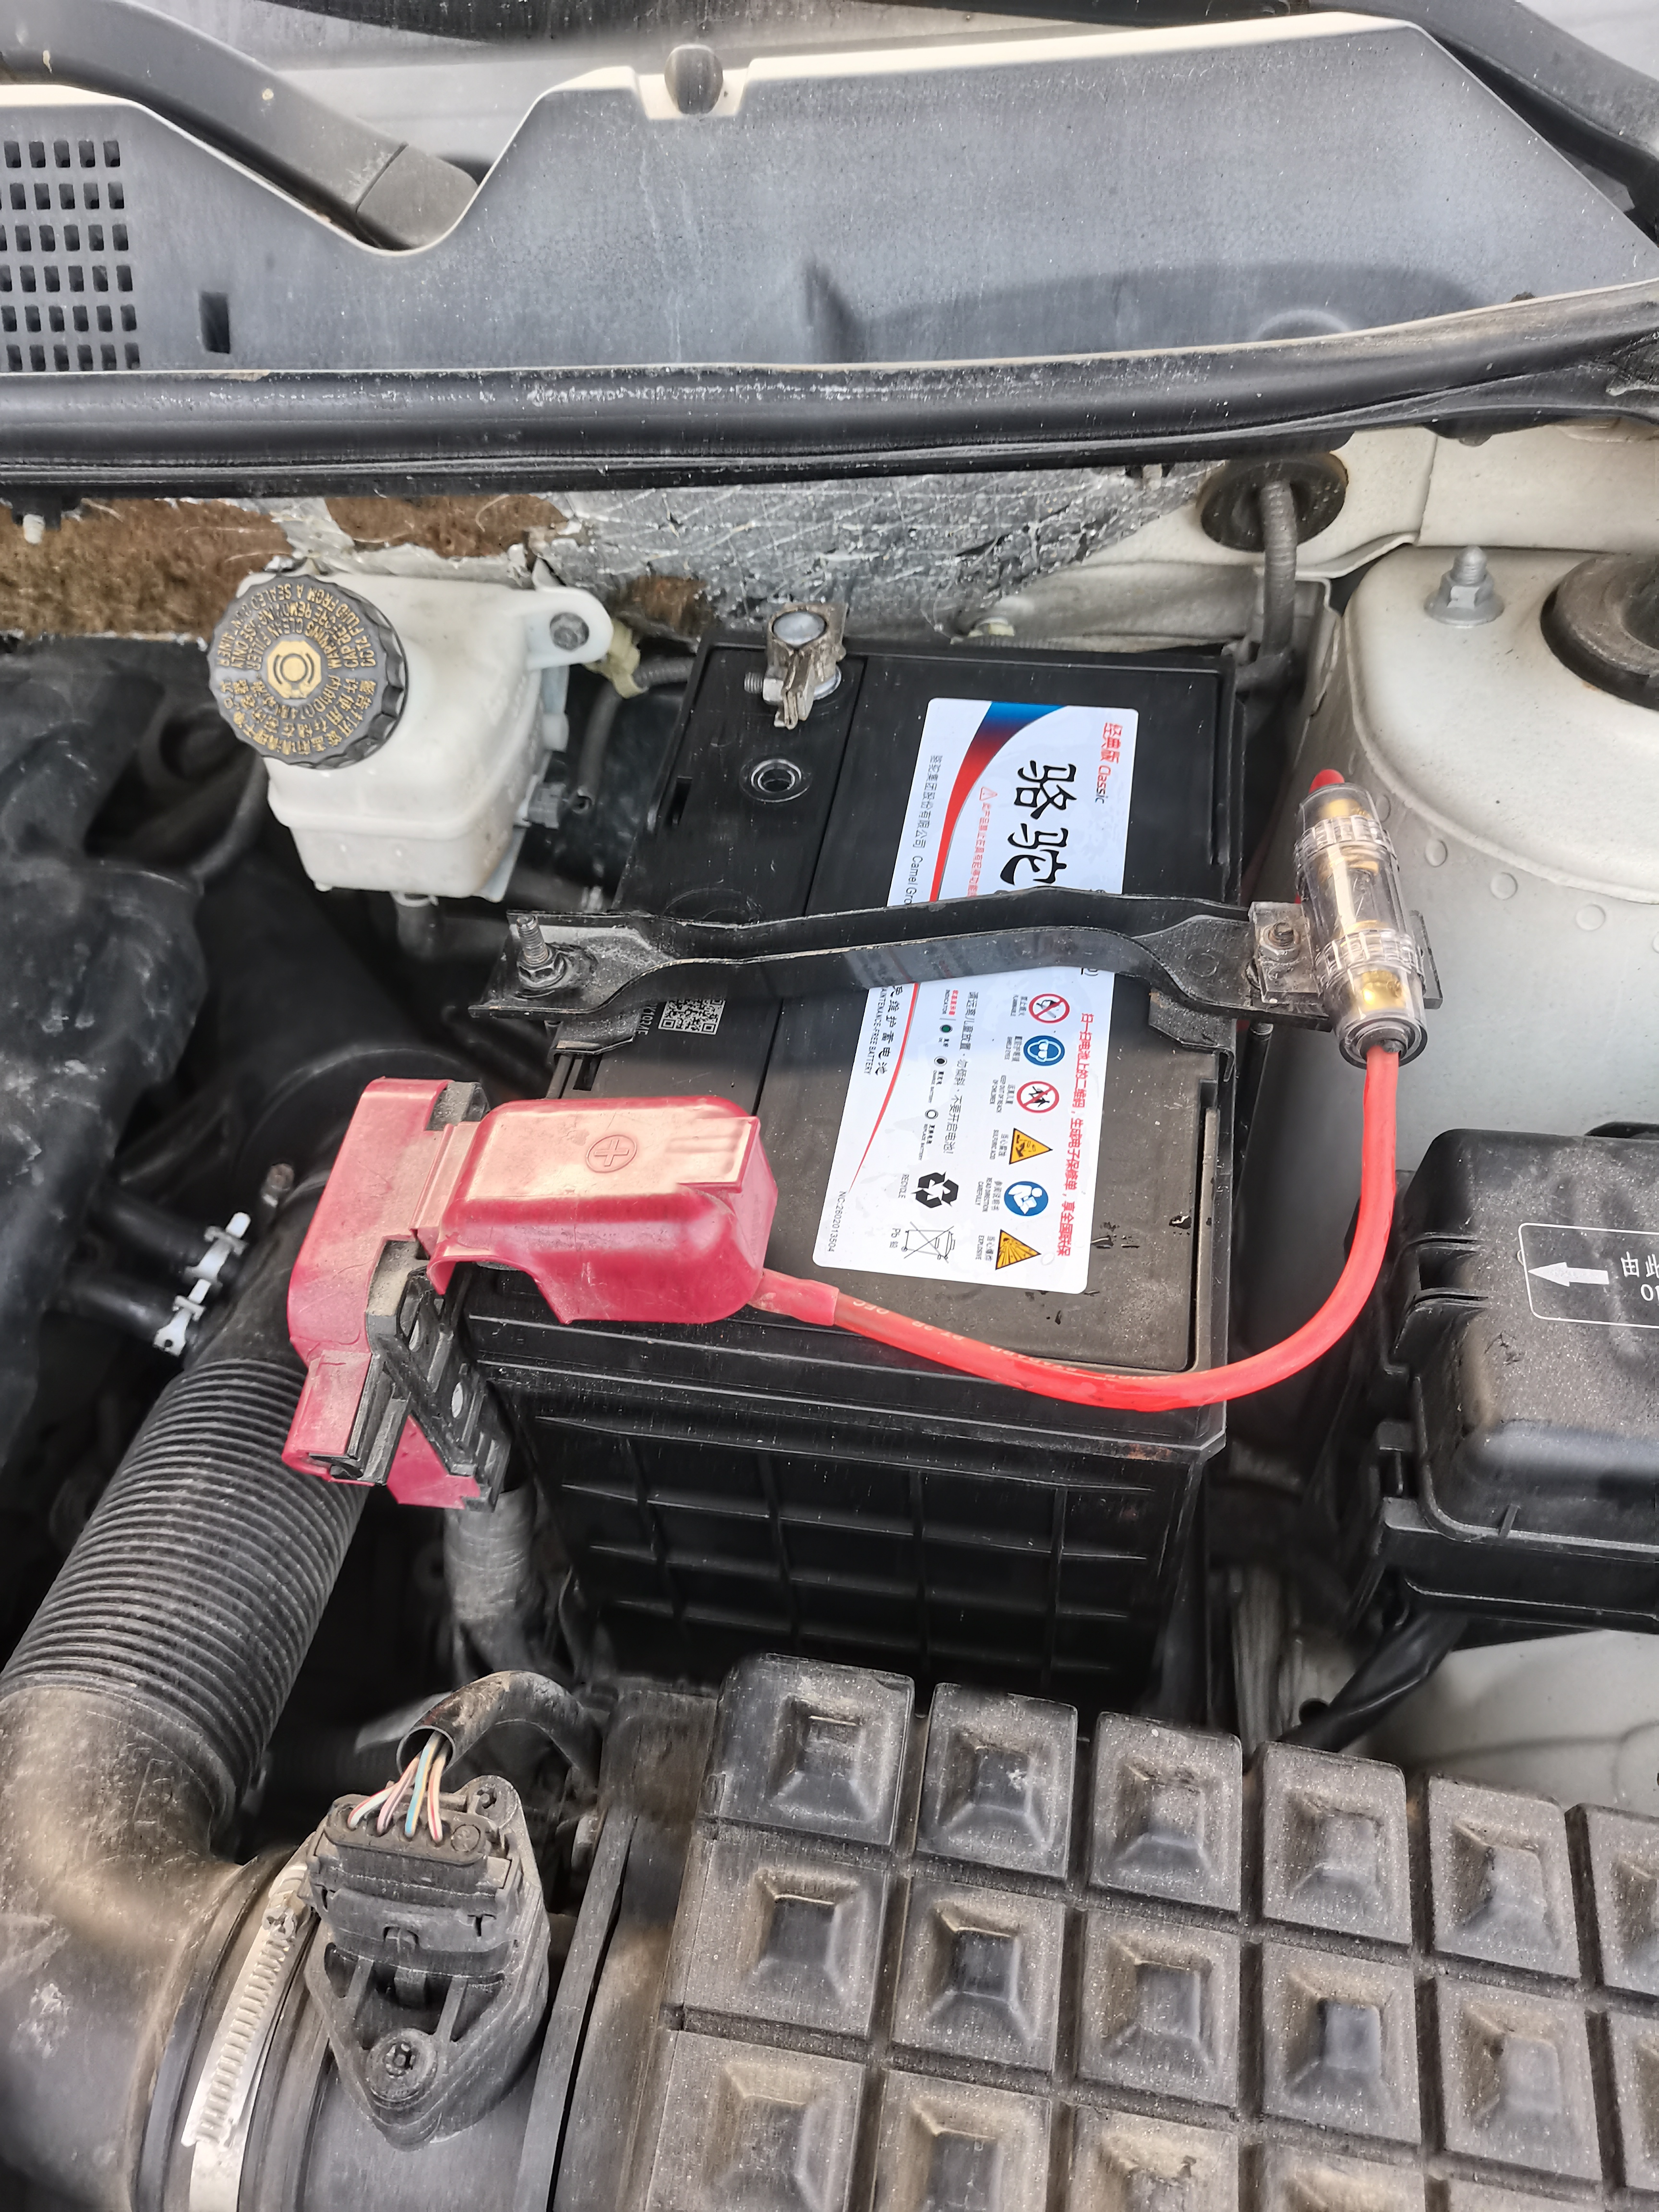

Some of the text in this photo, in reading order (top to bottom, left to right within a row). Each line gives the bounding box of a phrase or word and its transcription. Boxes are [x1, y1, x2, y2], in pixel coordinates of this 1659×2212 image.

[252, 583, 292, 610] SEALED
[296, 583, 304, 599] A
[307, 587, 340, 611] FROM
[230, 636, 250, 669] ONLY
[246, 631, 272, 671] FILLER
[340, 643, 359, 668] CAP
[1094, 722, 1121, 804] 经典版 Classic
[912, 755, 942, 848] 骆驼集团股份有限公司
[1000, 760, 1076, 886] 骆驼
[908, 855, 923, 885] Camel
[865, 988, 887, 1073] AINTENANCE-FREE BATTERY
[875, 986, 902, 1075] 免维护蓄电池
[898, 1174, 910, 1198] RECYCLE
[828, 1191, 846, 1251] NC:2602013504
[890, 1227, 901, 1238] Pb
